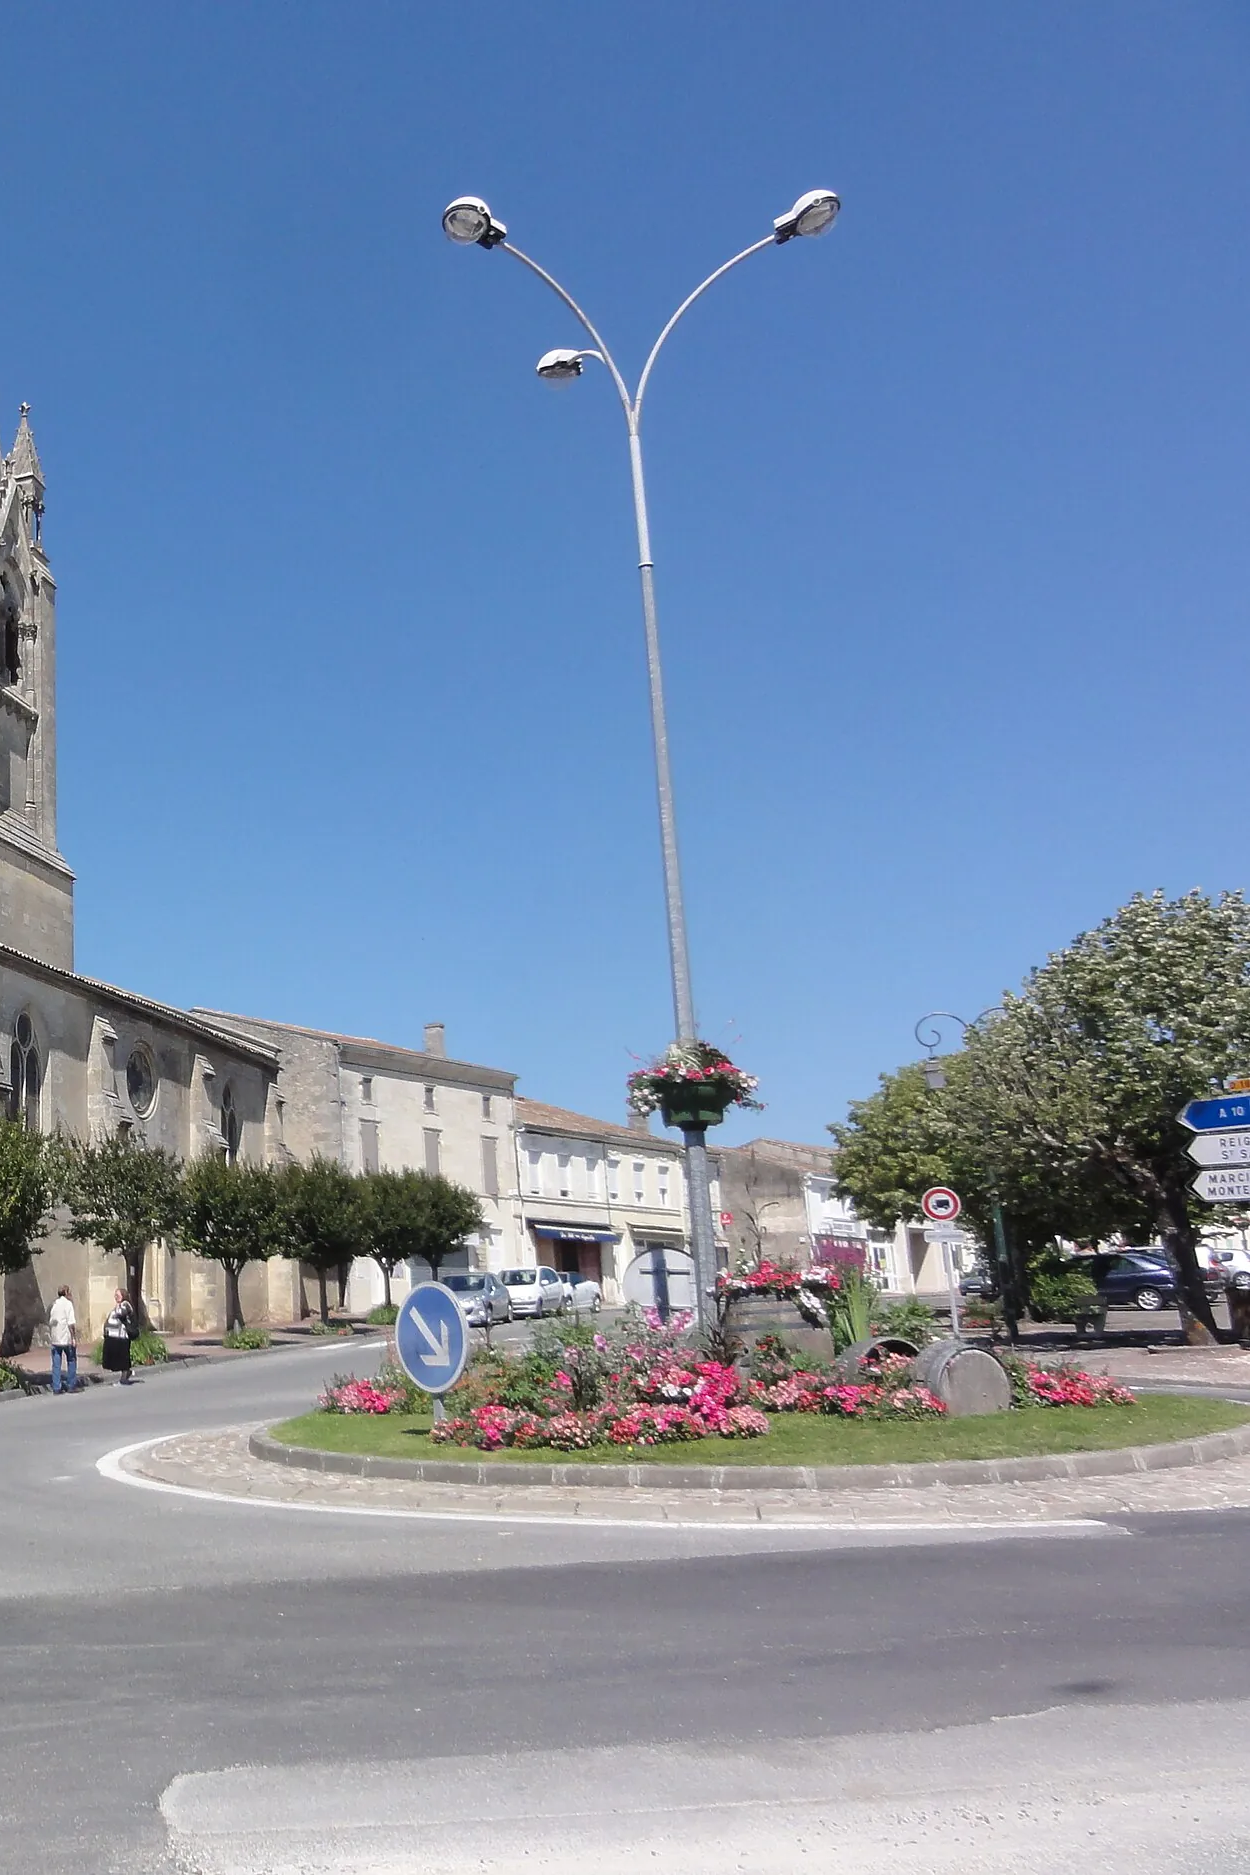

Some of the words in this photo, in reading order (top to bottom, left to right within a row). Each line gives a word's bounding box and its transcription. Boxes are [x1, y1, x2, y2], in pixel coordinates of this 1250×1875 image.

[1219, 1108, 1227, 1118] A
[1231, 1106, 1244, 1116] 10
[1240, 1149, 1250, 1159] S
[1208, 1172, 1250, 1184] MARCI
[1207, 1185, 1250, 1197] MONTE
